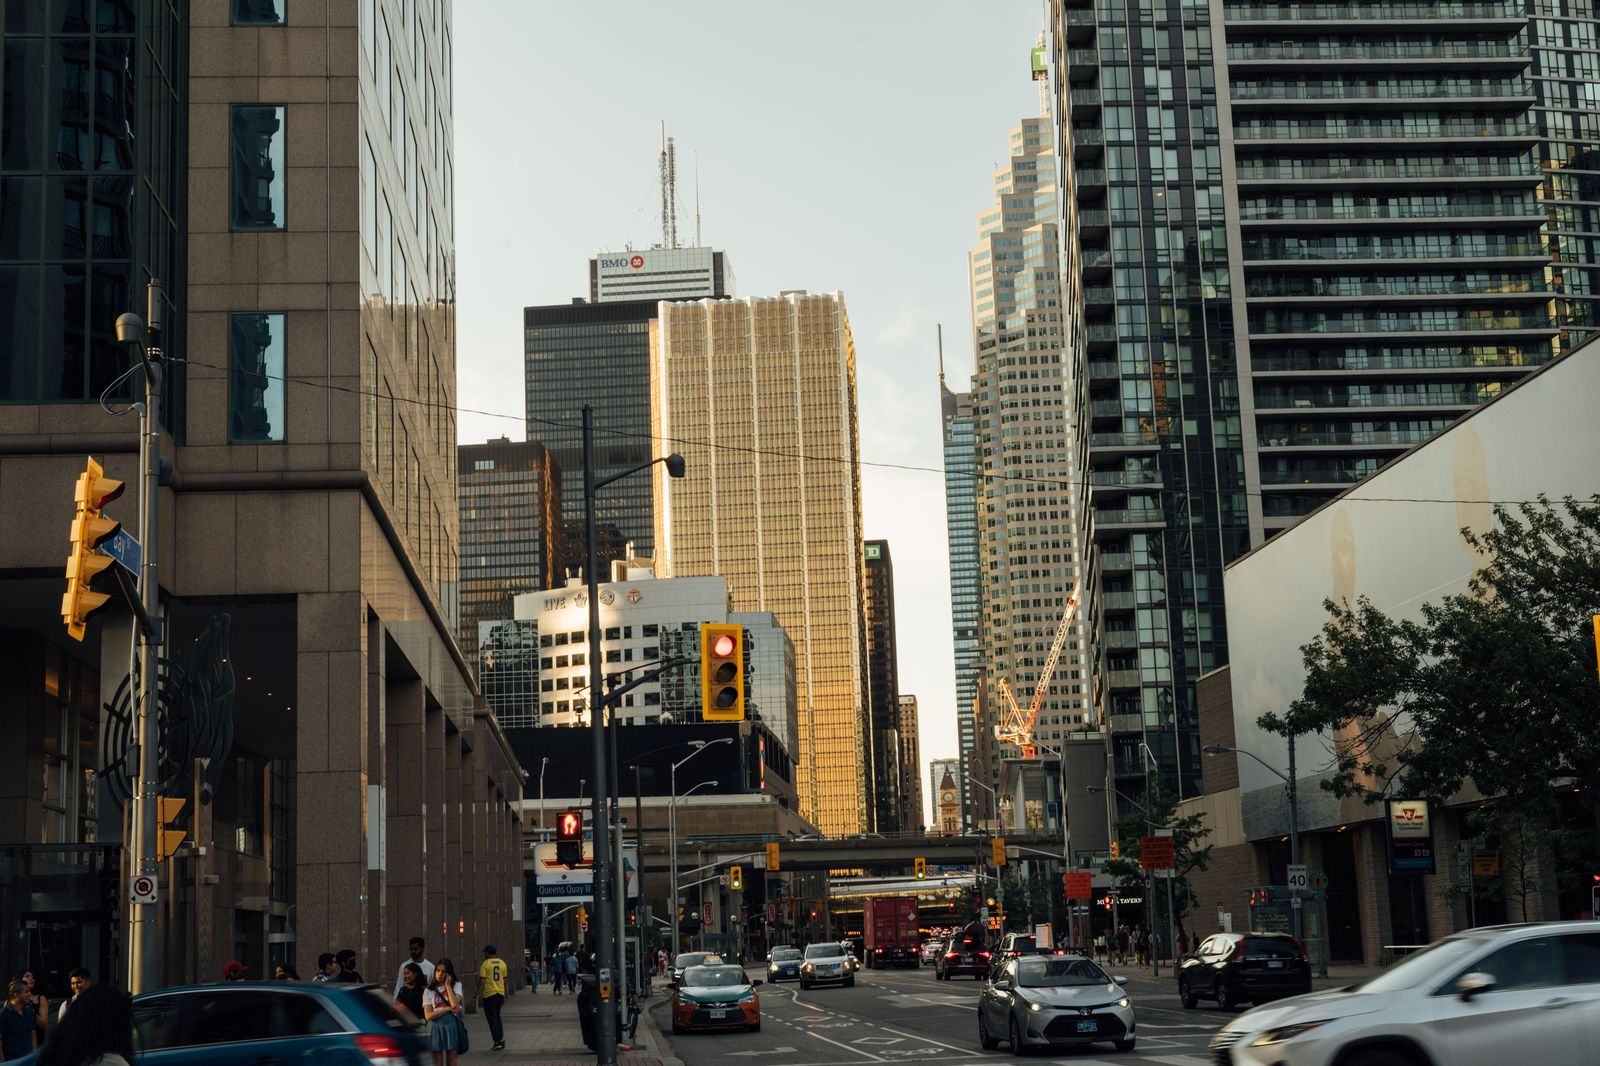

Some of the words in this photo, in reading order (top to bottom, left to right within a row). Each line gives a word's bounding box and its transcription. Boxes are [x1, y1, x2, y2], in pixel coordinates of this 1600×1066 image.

[601, 258, 628, 269] BMO
[865, 547, 879, 557] TD
[543, 597, 566, 611] LIVE
[1289, 875, 1305, 886] 40
[539, 885, 565, 895] Queens
[566, 885, 584, 895] Quay
[584, 884, 592, 893] W
[493, 966, 500, 981] 6
